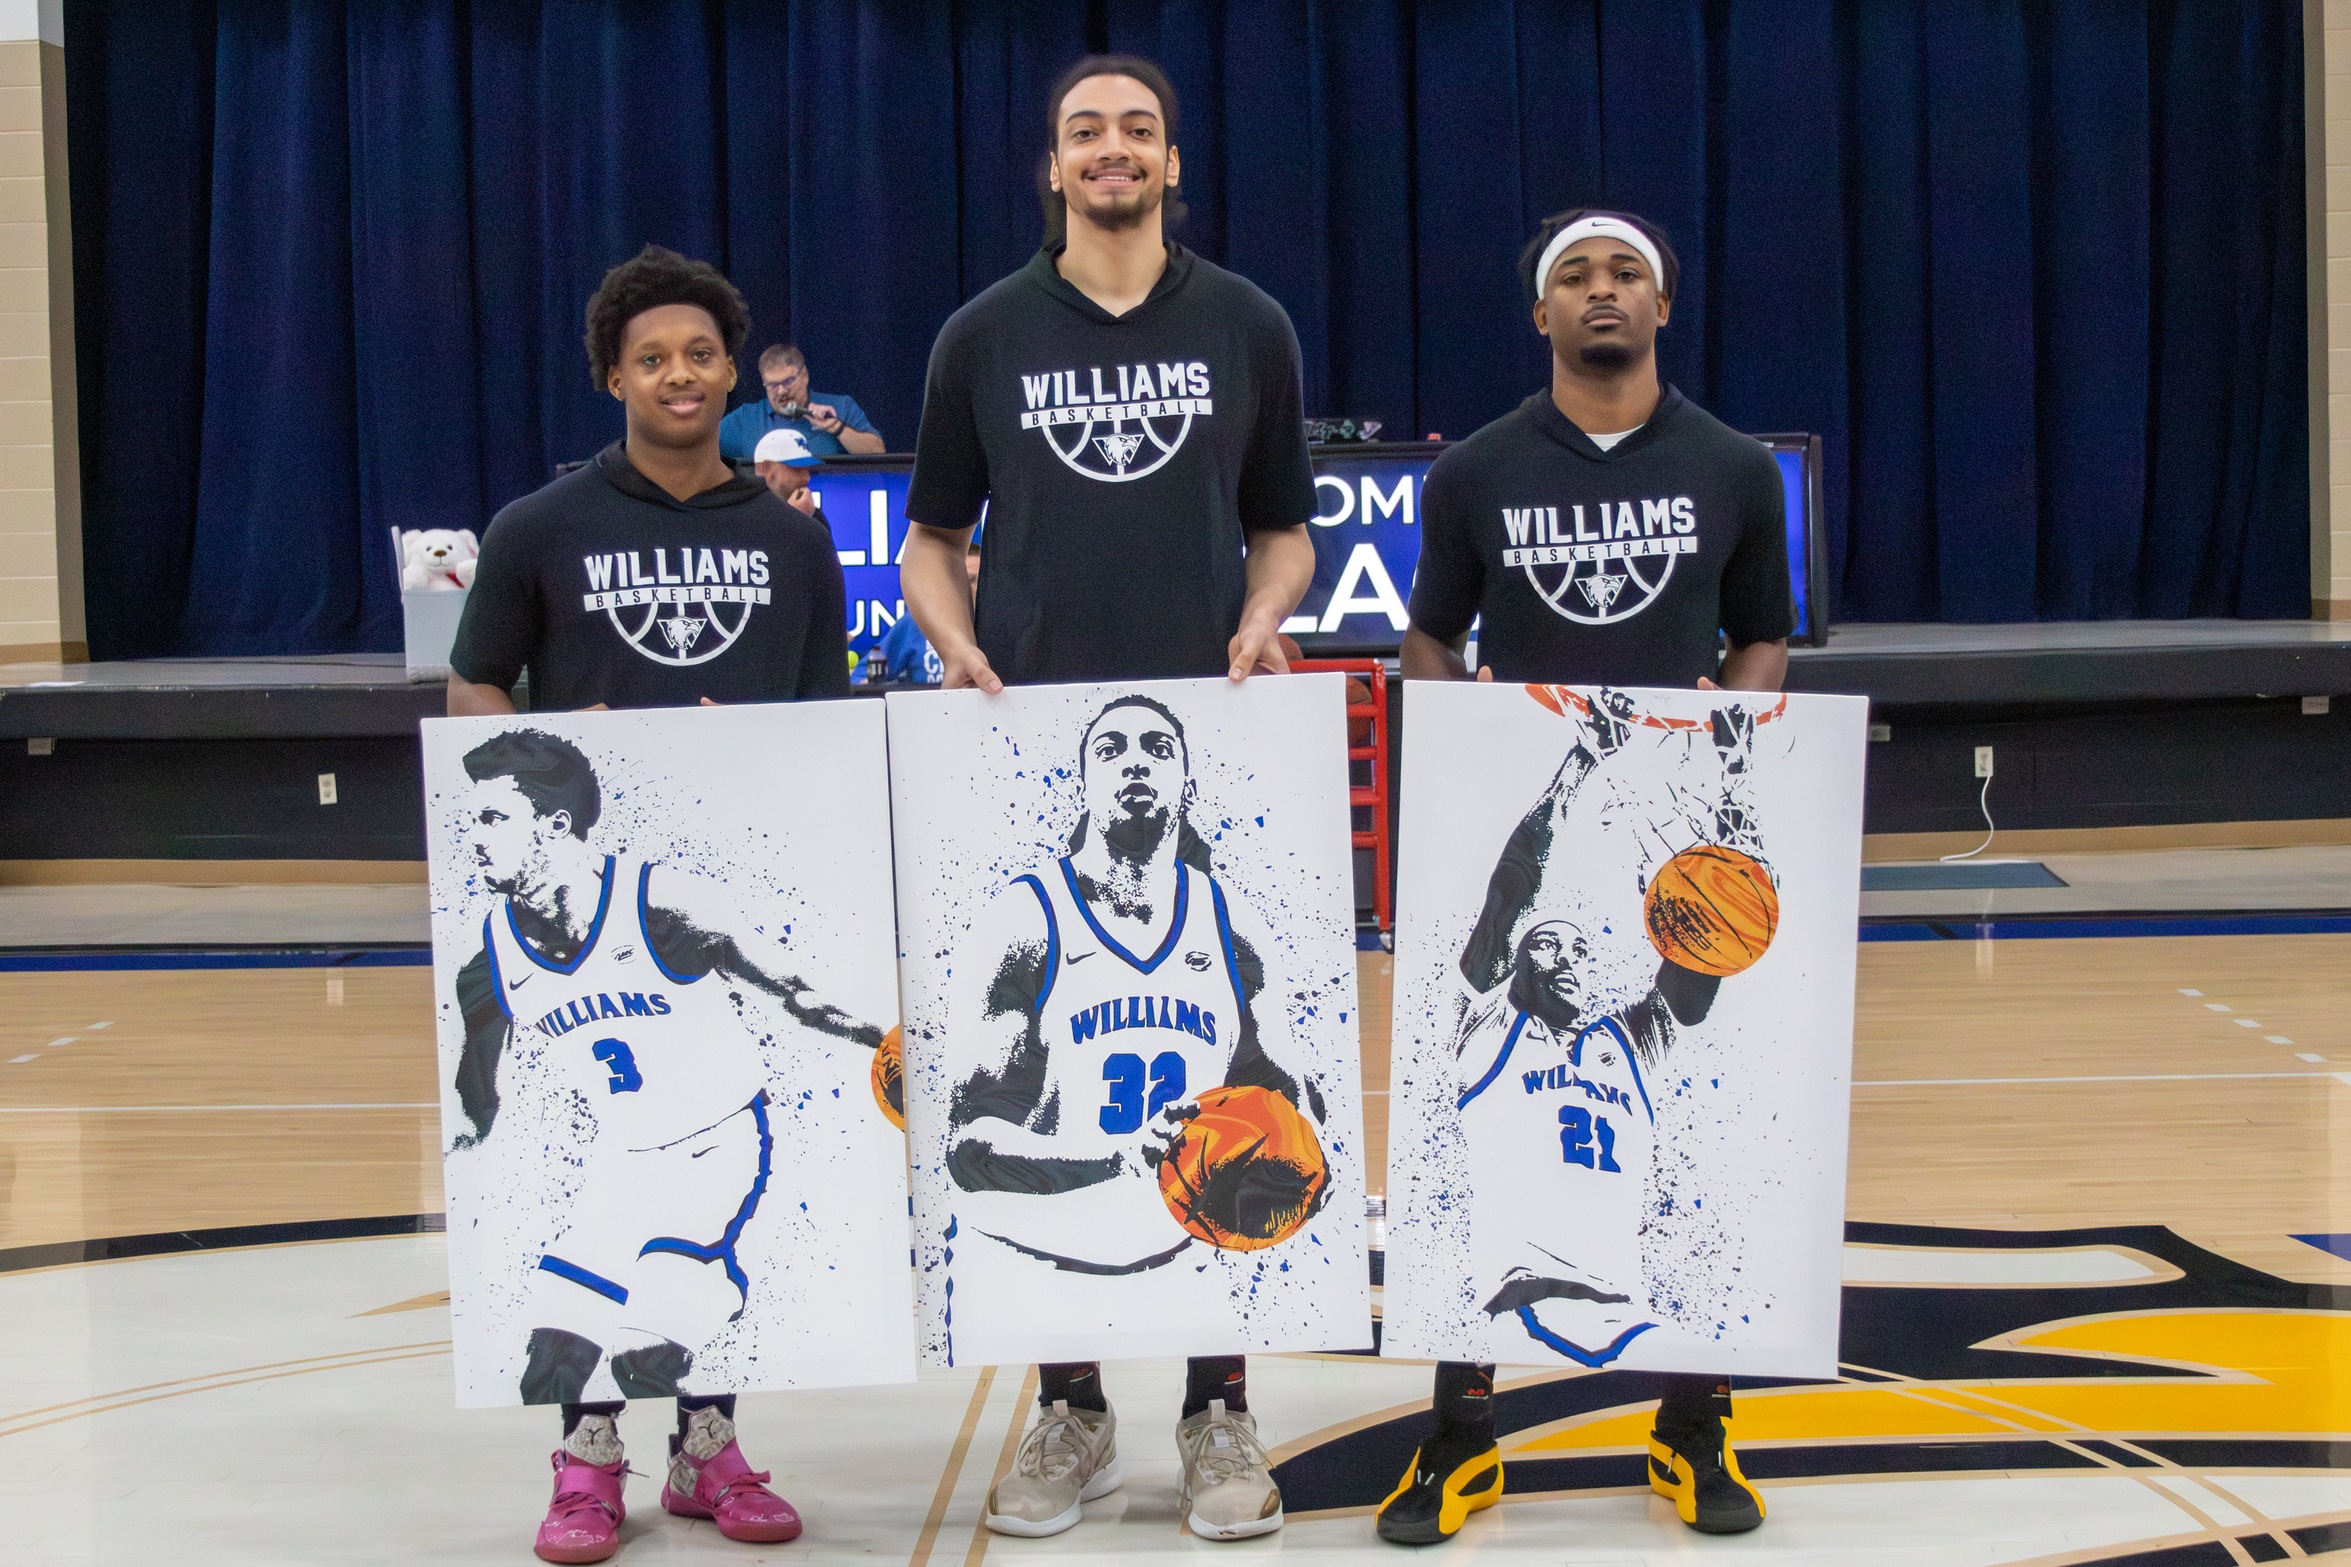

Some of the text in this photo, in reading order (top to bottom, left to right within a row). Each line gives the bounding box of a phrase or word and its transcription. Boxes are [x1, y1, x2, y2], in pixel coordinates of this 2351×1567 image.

[1020, 361, 1210, 410] WILLIAMS
[1031, 400, 1202, 426] BASKETBALL
[1501, 496, 1696, 546] WILLIAMS
[583, 547, 771, 591] WILLIAMS
[1513, 539, 1686, 564] BASKETBALL
[595, 587, 761, 608] BASKETBALL
[591, 1037, 644, 1095] 3
[1098, 1050, 1187, 1136] 32
[1557, 1104, 1622, 1174] 21
